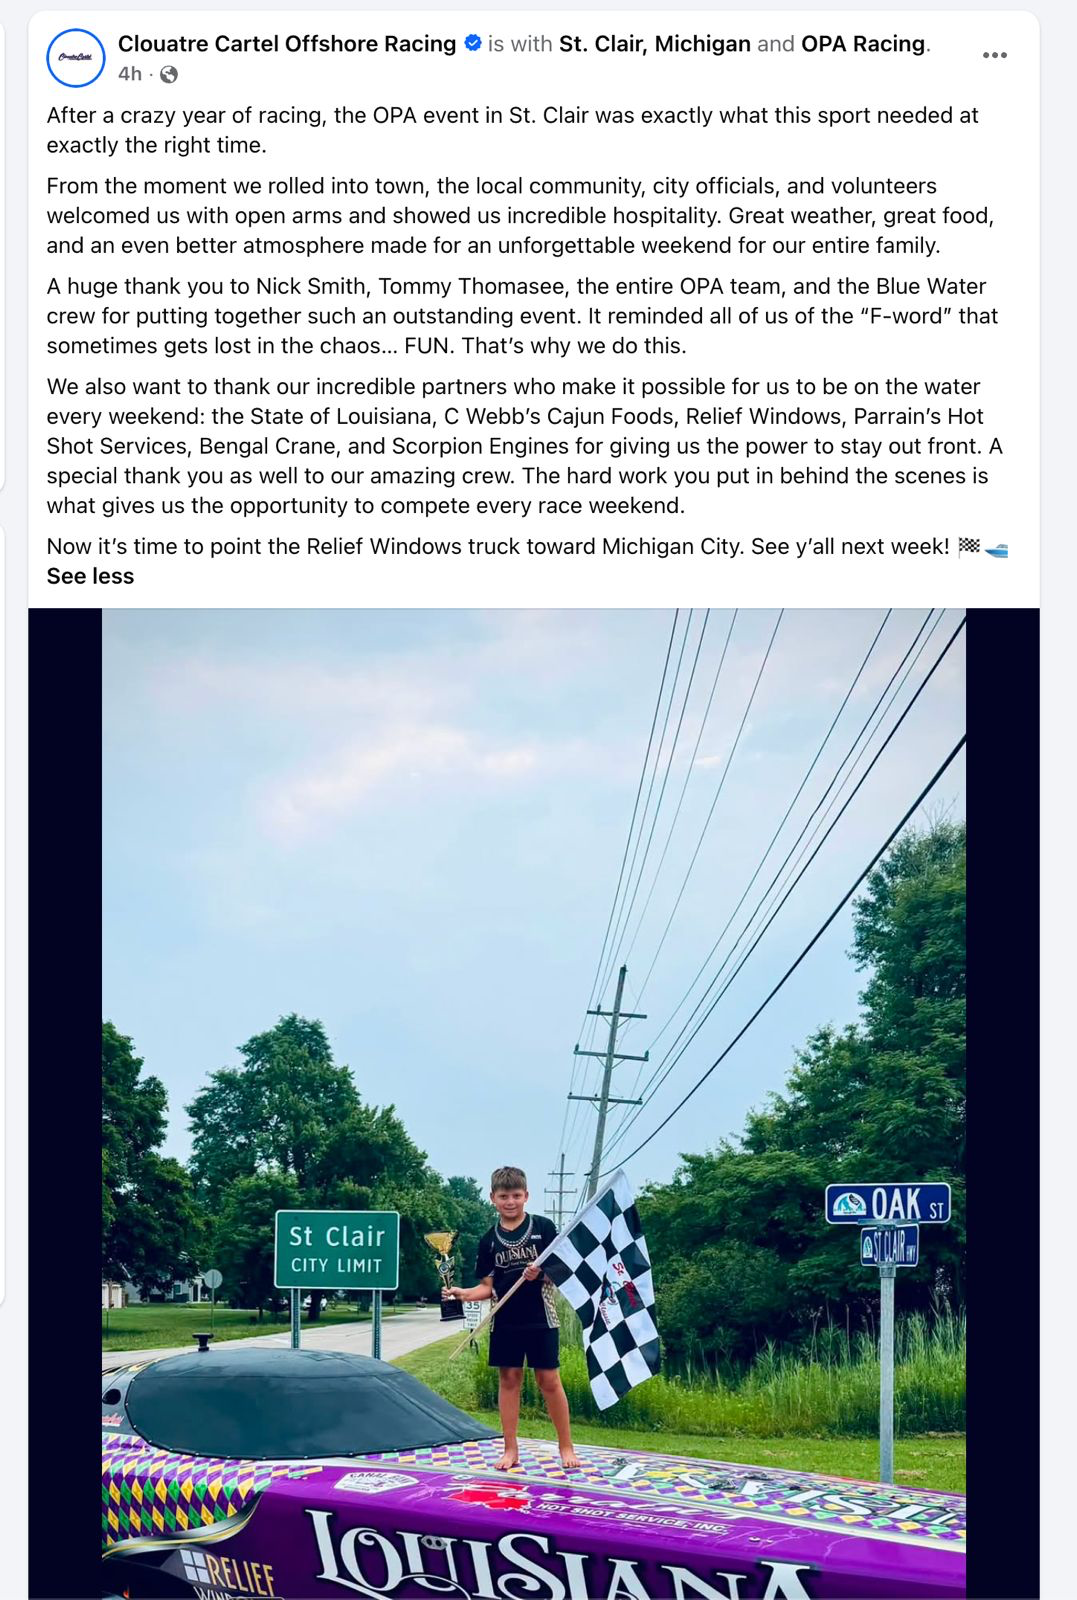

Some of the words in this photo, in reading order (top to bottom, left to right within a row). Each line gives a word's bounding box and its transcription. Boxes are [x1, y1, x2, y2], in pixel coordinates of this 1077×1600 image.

[872, 1187, 921, 1220] OAK
[929, 1202, 944, 1219] ST
[289, 1226, 313, 1247] St
[326, 1225, 385, 1247] Clair
[883, 1229, 906, 1262] CLAIR
[291, 1257, 328, 1272] CITY
[337, 1258, 383, 1273] LIMIT
[466, 1301, 480, 1310] 35
[536, 1502, 570, 1513] HOT
[573, 1506, 615, 1518] SHOT
[694, 1522, 729, 1533] INC.
[205, 1553, 275, 1597] RELIEF
